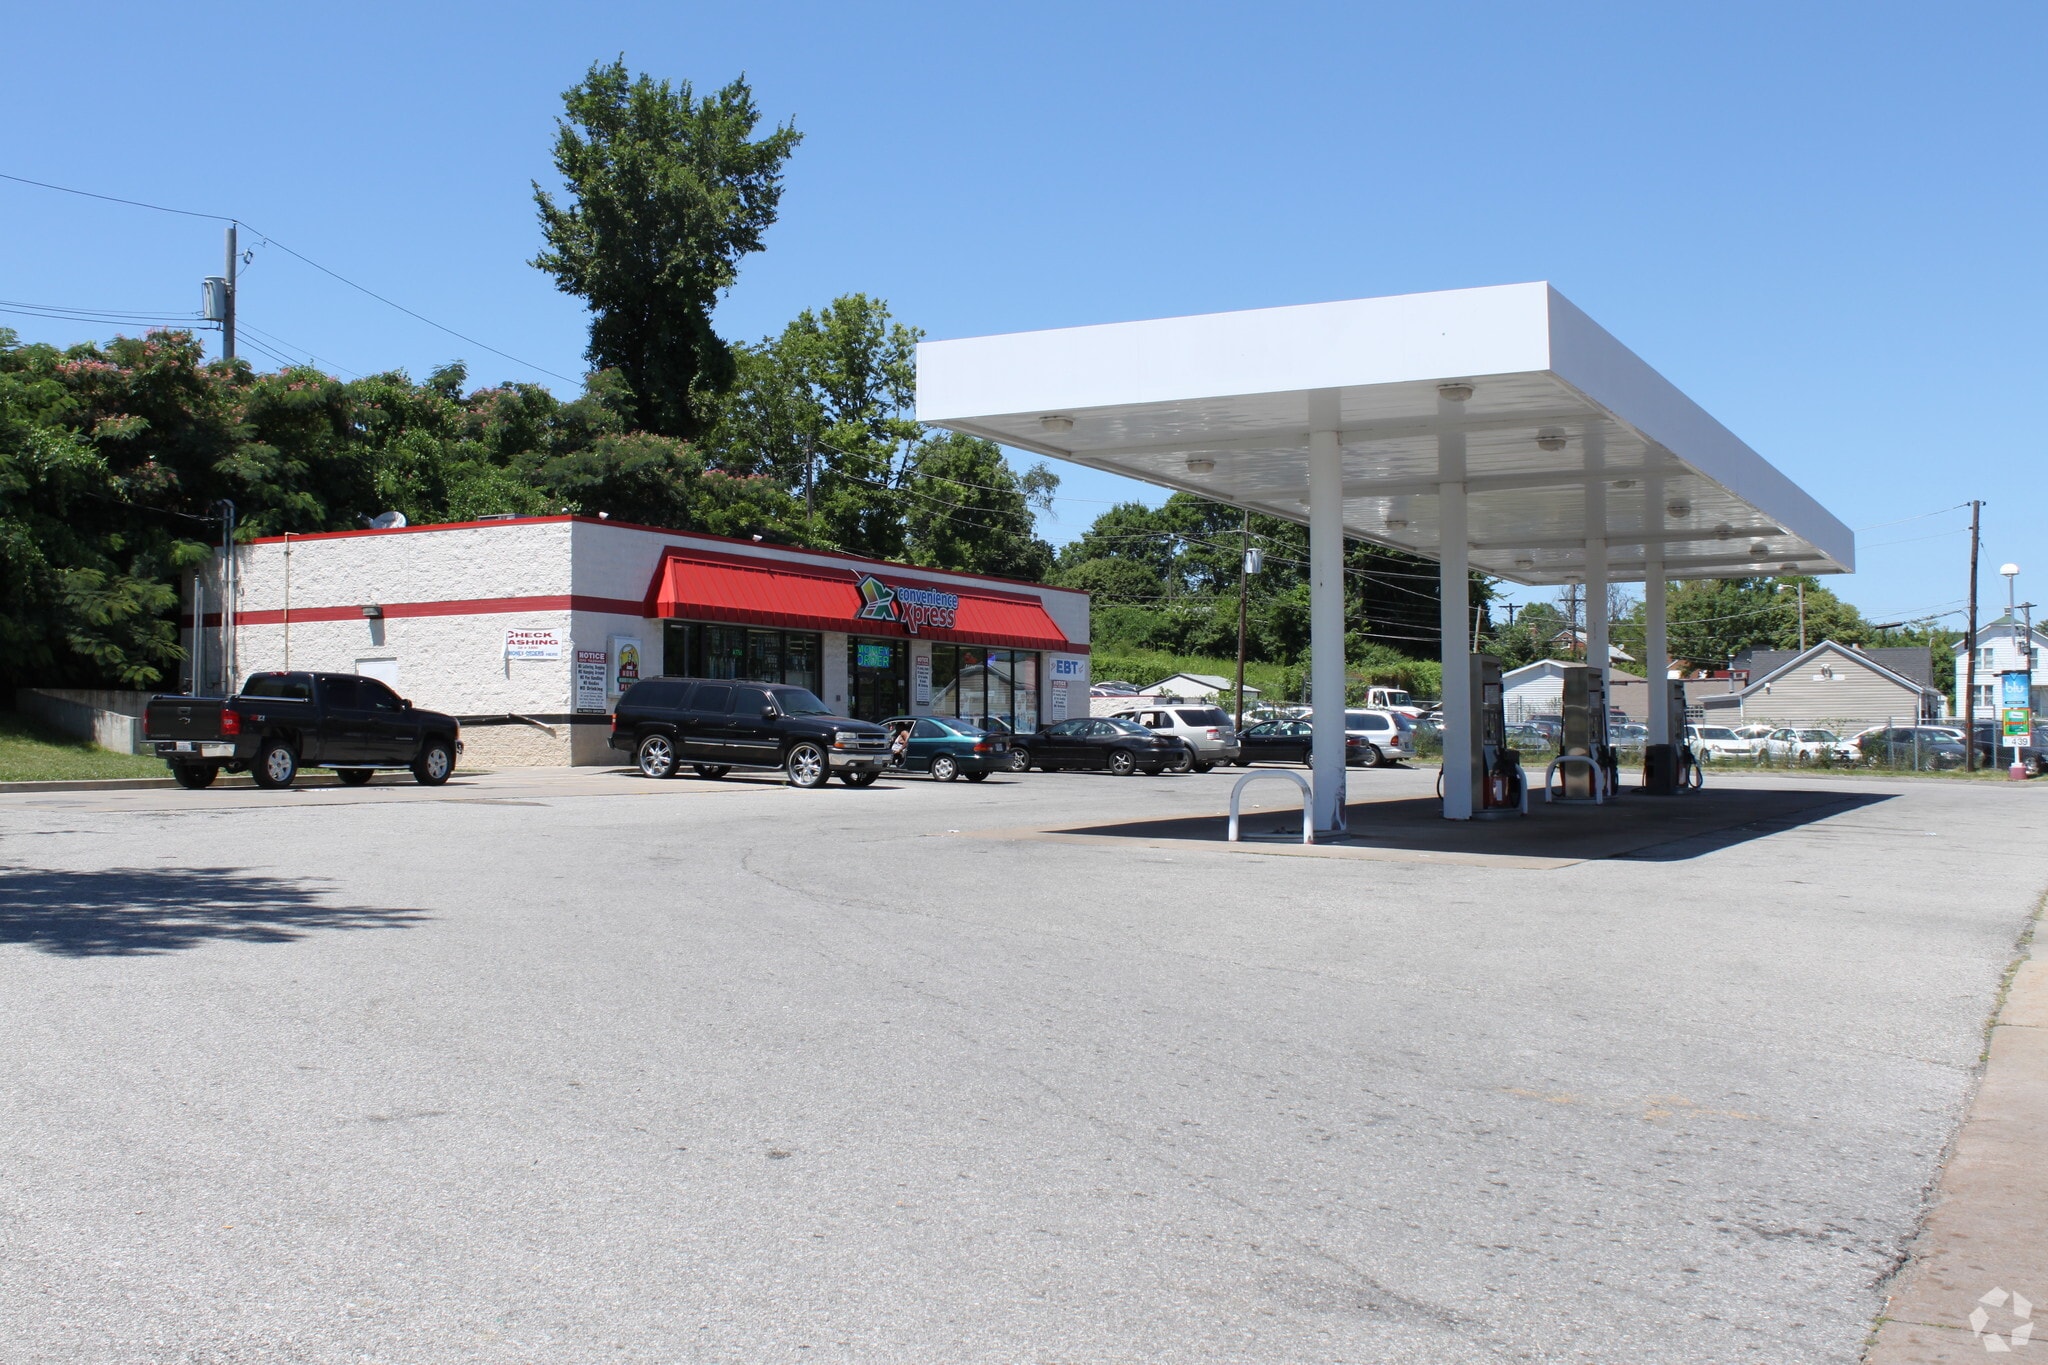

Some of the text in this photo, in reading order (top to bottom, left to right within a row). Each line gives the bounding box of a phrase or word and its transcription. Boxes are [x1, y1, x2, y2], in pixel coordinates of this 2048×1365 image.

[898, 587, 958, 609] convenience
[901, 601, 955, 634] Xpress
[579, 652, 605, 660] NOTICE
[857, 644, 890, 656] MONEY
[857, 654, 890, 668] ORDER
[1056, 660, 1079, 674] EBT
[2005, 681, 2024, 693] blu
